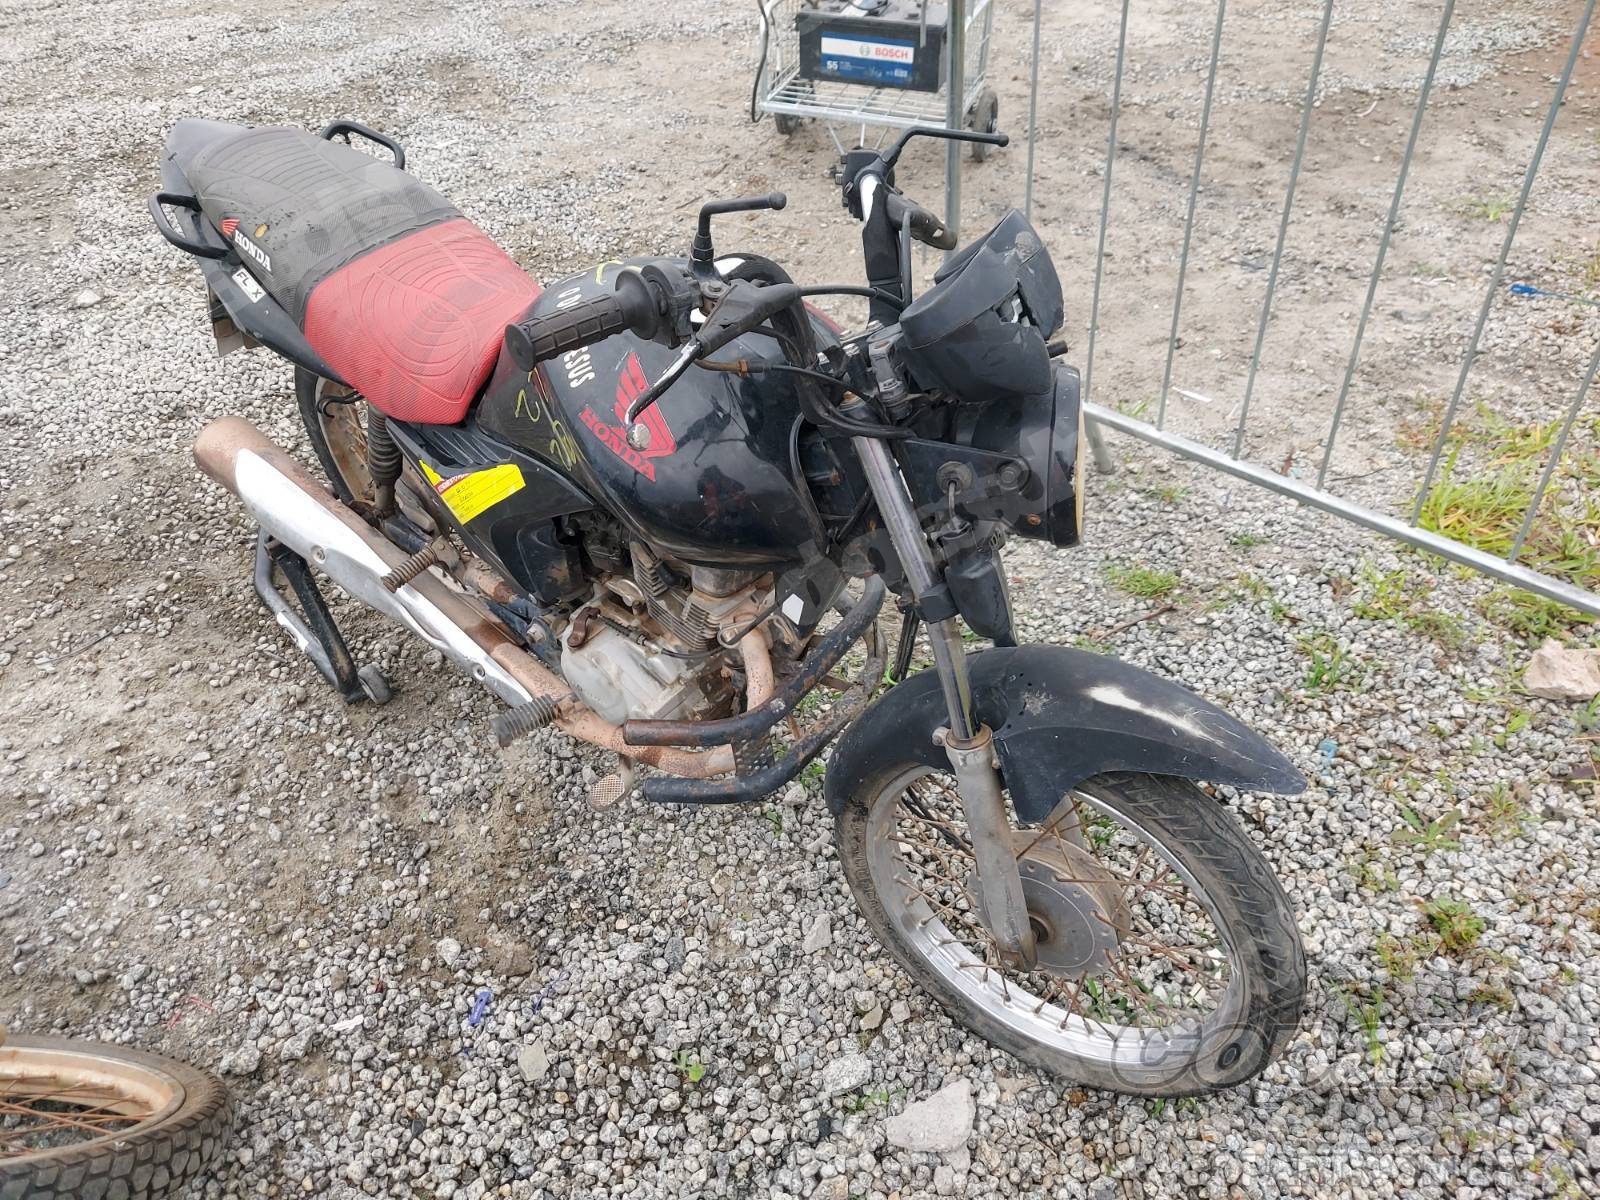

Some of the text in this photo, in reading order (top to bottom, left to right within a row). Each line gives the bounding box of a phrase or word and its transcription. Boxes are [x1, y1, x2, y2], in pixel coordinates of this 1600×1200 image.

[826, 60, 839, 71] 55
[874, 47, 909, 59] BOSCH
[234, 229, 272, 272] HONDA
[236, 271, 262, 299] FLX
[563, 345, 596, 388] ESUS
[578, 406, 657, 483] HONDA
